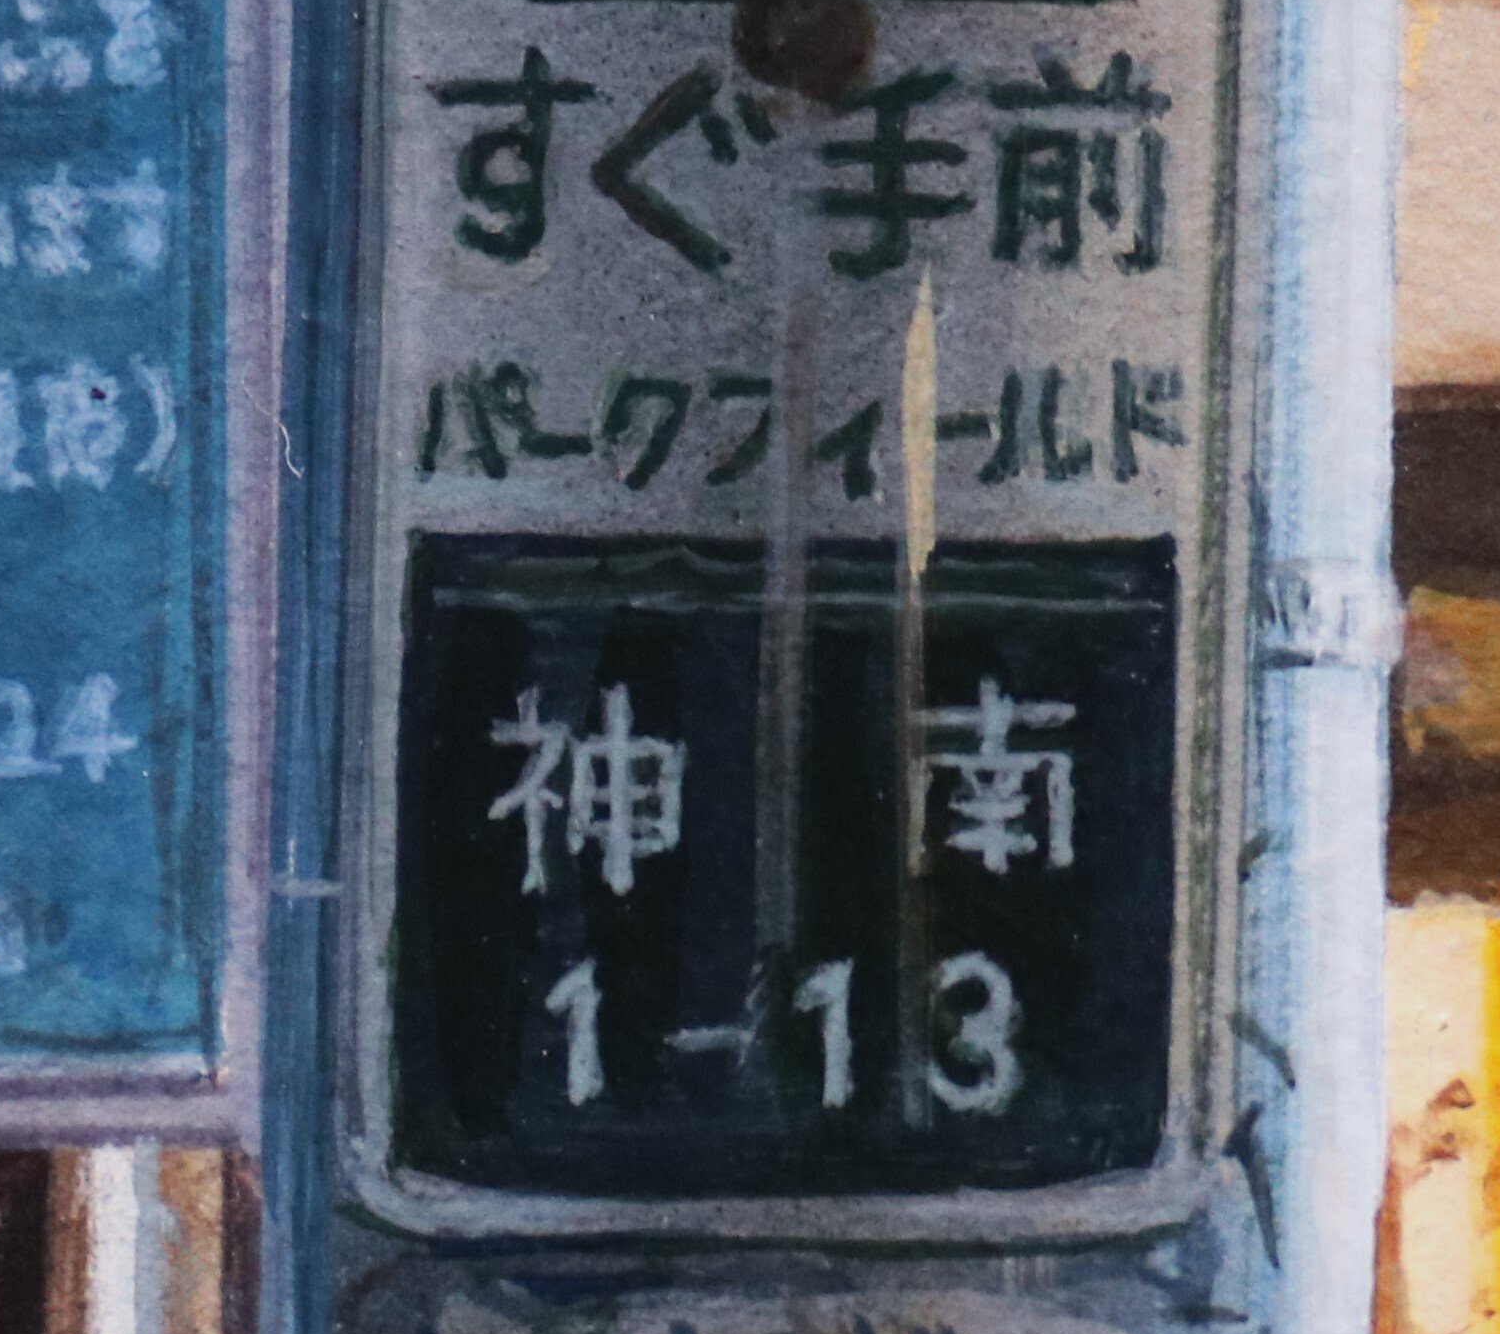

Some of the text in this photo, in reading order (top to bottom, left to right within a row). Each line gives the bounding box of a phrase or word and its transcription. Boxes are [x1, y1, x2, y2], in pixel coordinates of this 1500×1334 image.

[426, 45, 1173, 276] すぐ手前
[488, 677, 1078, 897] 神南
[545, 951, 1027, 1117] 1-13
